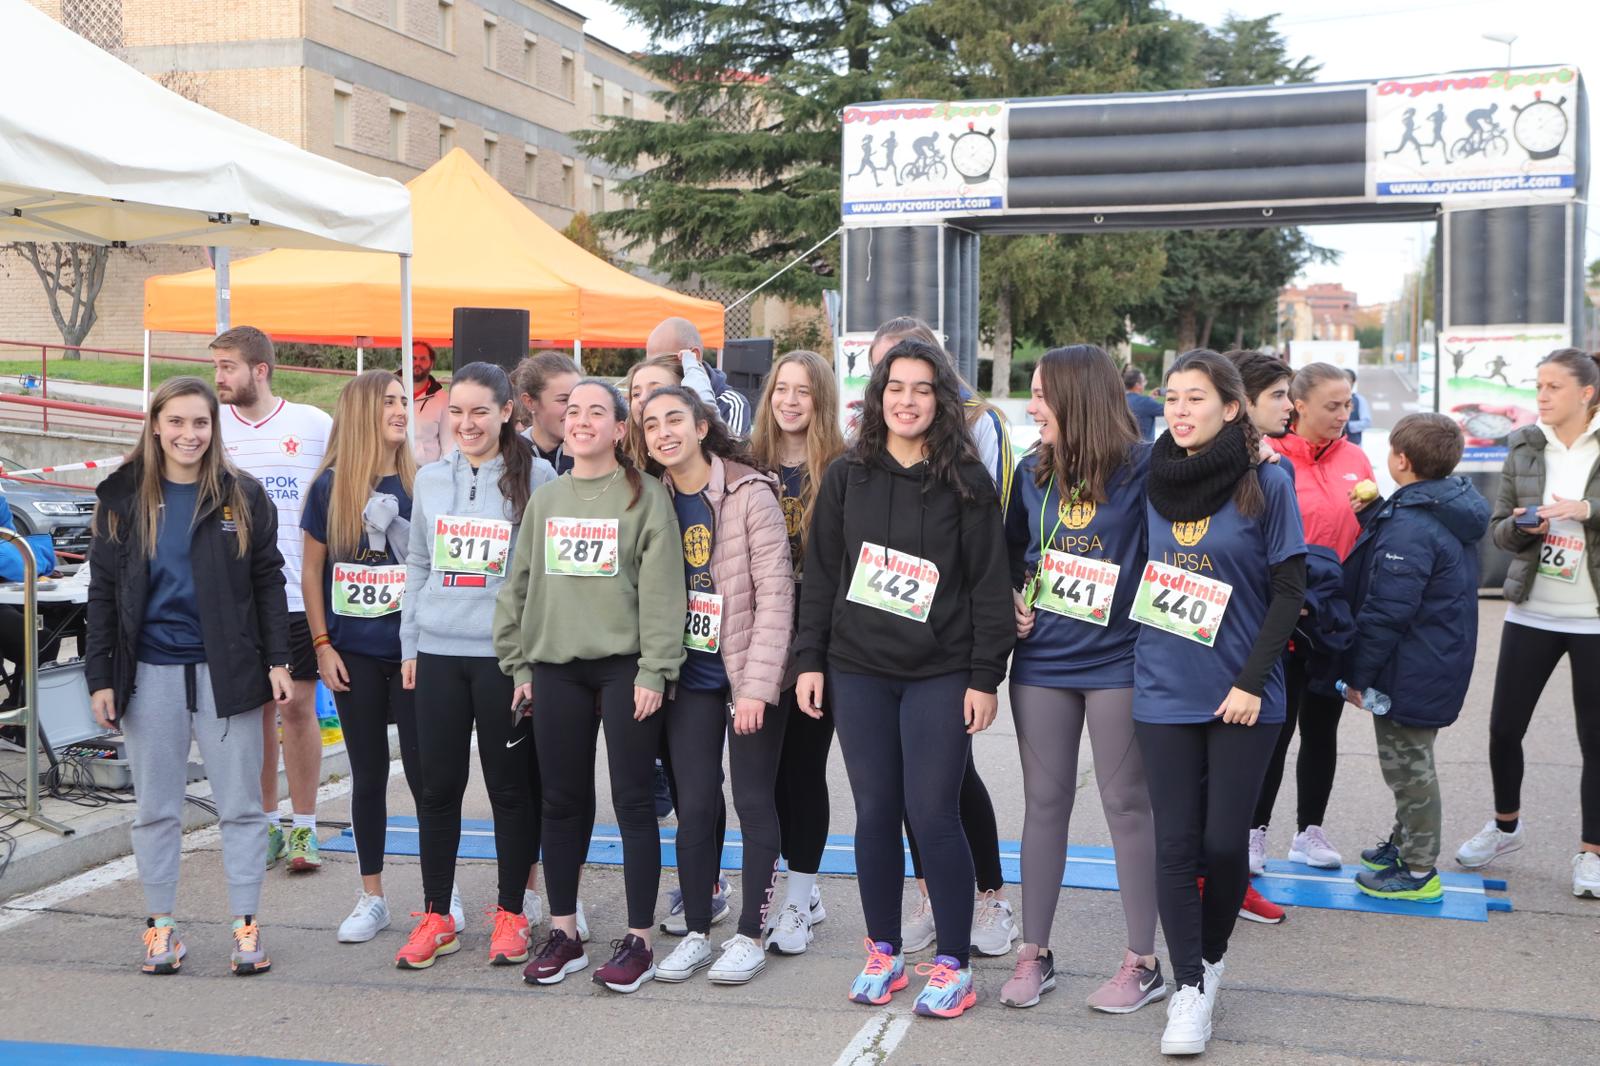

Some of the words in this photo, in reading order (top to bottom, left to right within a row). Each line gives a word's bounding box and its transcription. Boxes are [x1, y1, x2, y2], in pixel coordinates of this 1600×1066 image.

[1389, 175, 1561, 194] www.orycronsport.com
[851, 198, 991, 213] www.orycronsport.com
[256, 477, 298, 488] POK
[436, 518, 510, 541] bedunia
[547, 521, 617, 540] bedunia
[448, 537, 491, 561] 311
[558, 539, 604, 562] 287
[1052, 535, 1103, 553] UPSA
[861, 547, 938, 585] bedunia
[1043, 553, 1117, 587] bedunia
[1164, 551, 1214, 571] UPSA
[335, 567, 406, 584] bedunia
[867, 569, 920, 604] 442
[1144, 564, 1228, 606] bedunia
[347, 584, 392, 605] 286
[1051, 575, 1097, 607] 441
[1152, 589, 1207, 624] 440
[684, 612, 711, 637] 288
